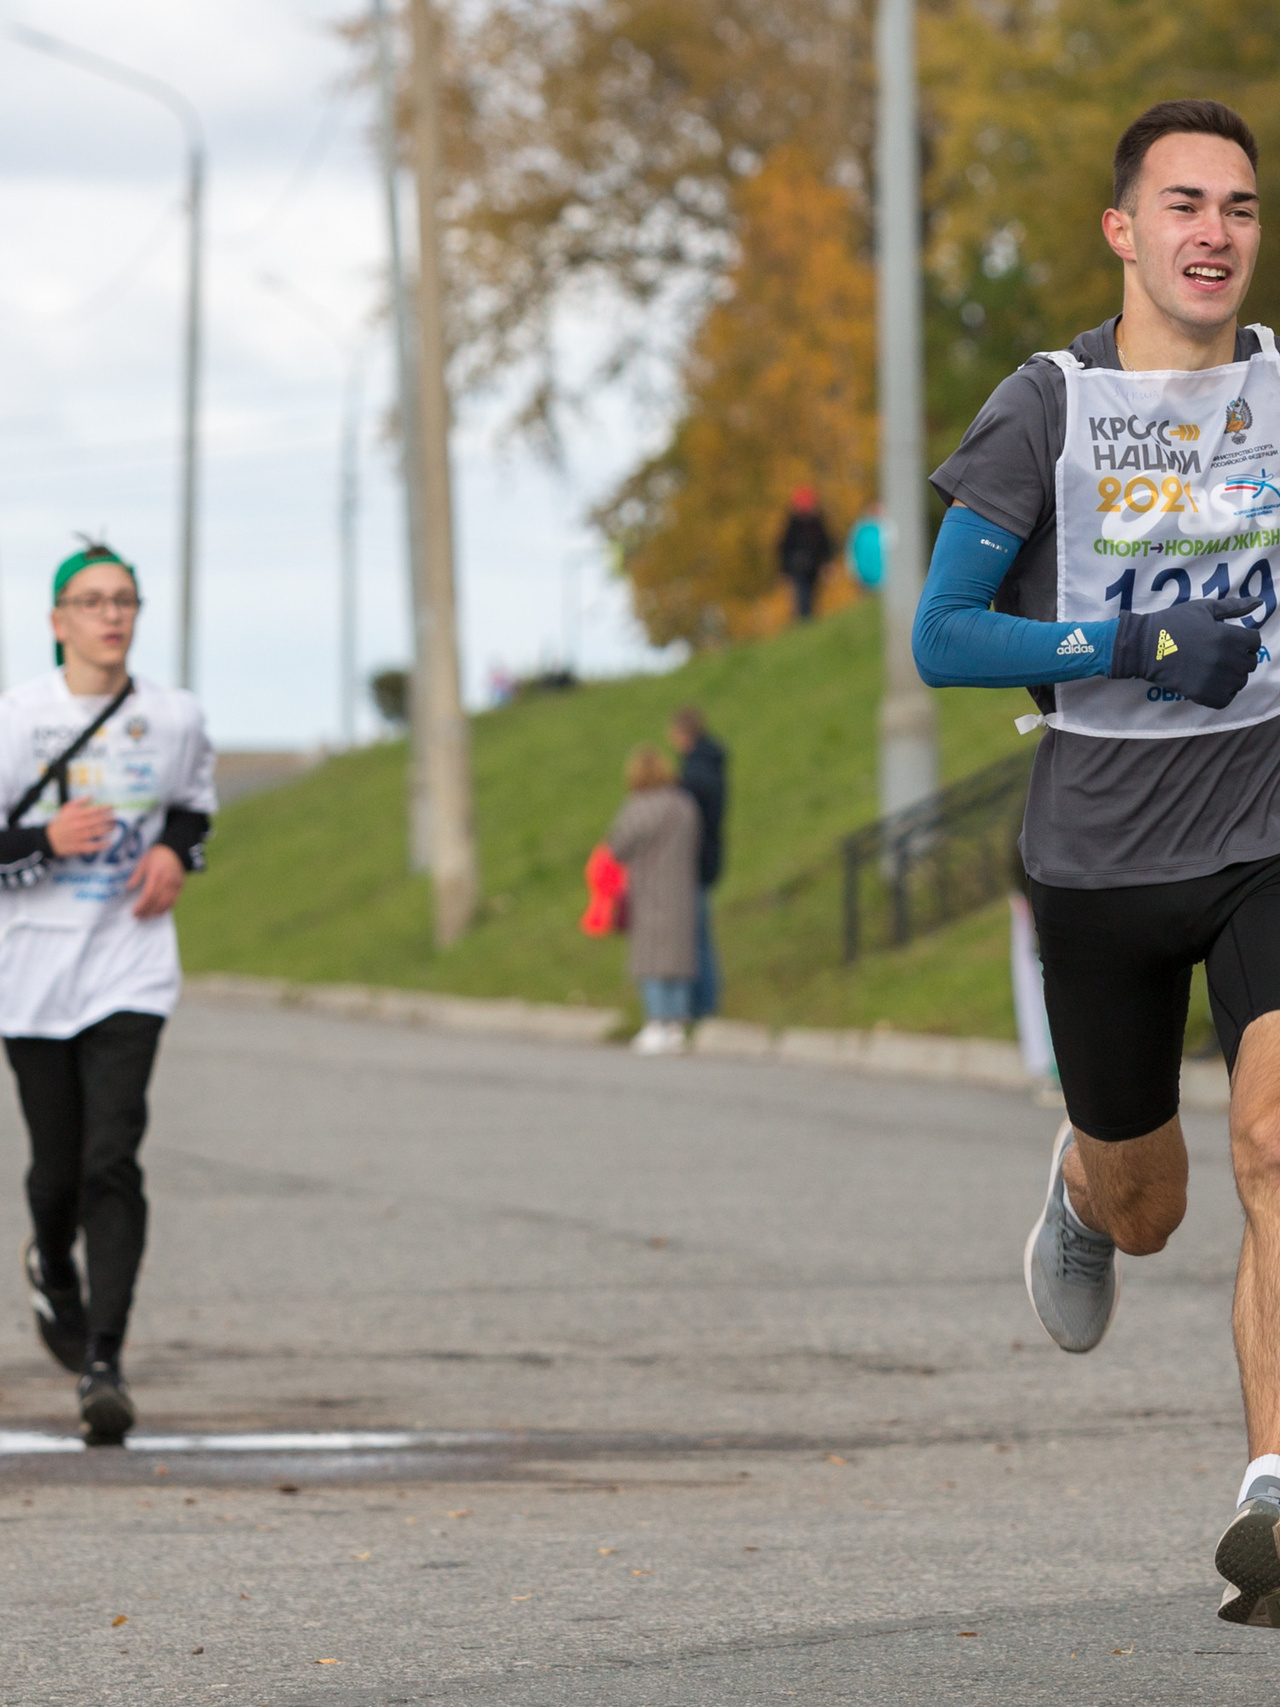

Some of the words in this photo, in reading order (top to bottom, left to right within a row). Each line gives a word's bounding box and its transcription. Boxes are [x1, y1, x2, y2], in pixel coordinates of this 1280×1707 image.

[1088, 414, 1172, 446] КРОСС
[1092, 444, 1202, 475] НАЦИИ
[1093, 538, 1151, 558] СПОРТ
[1164, 537, 1236, 557] НОРМА
[1056, 643, 1095, 655] adidas
